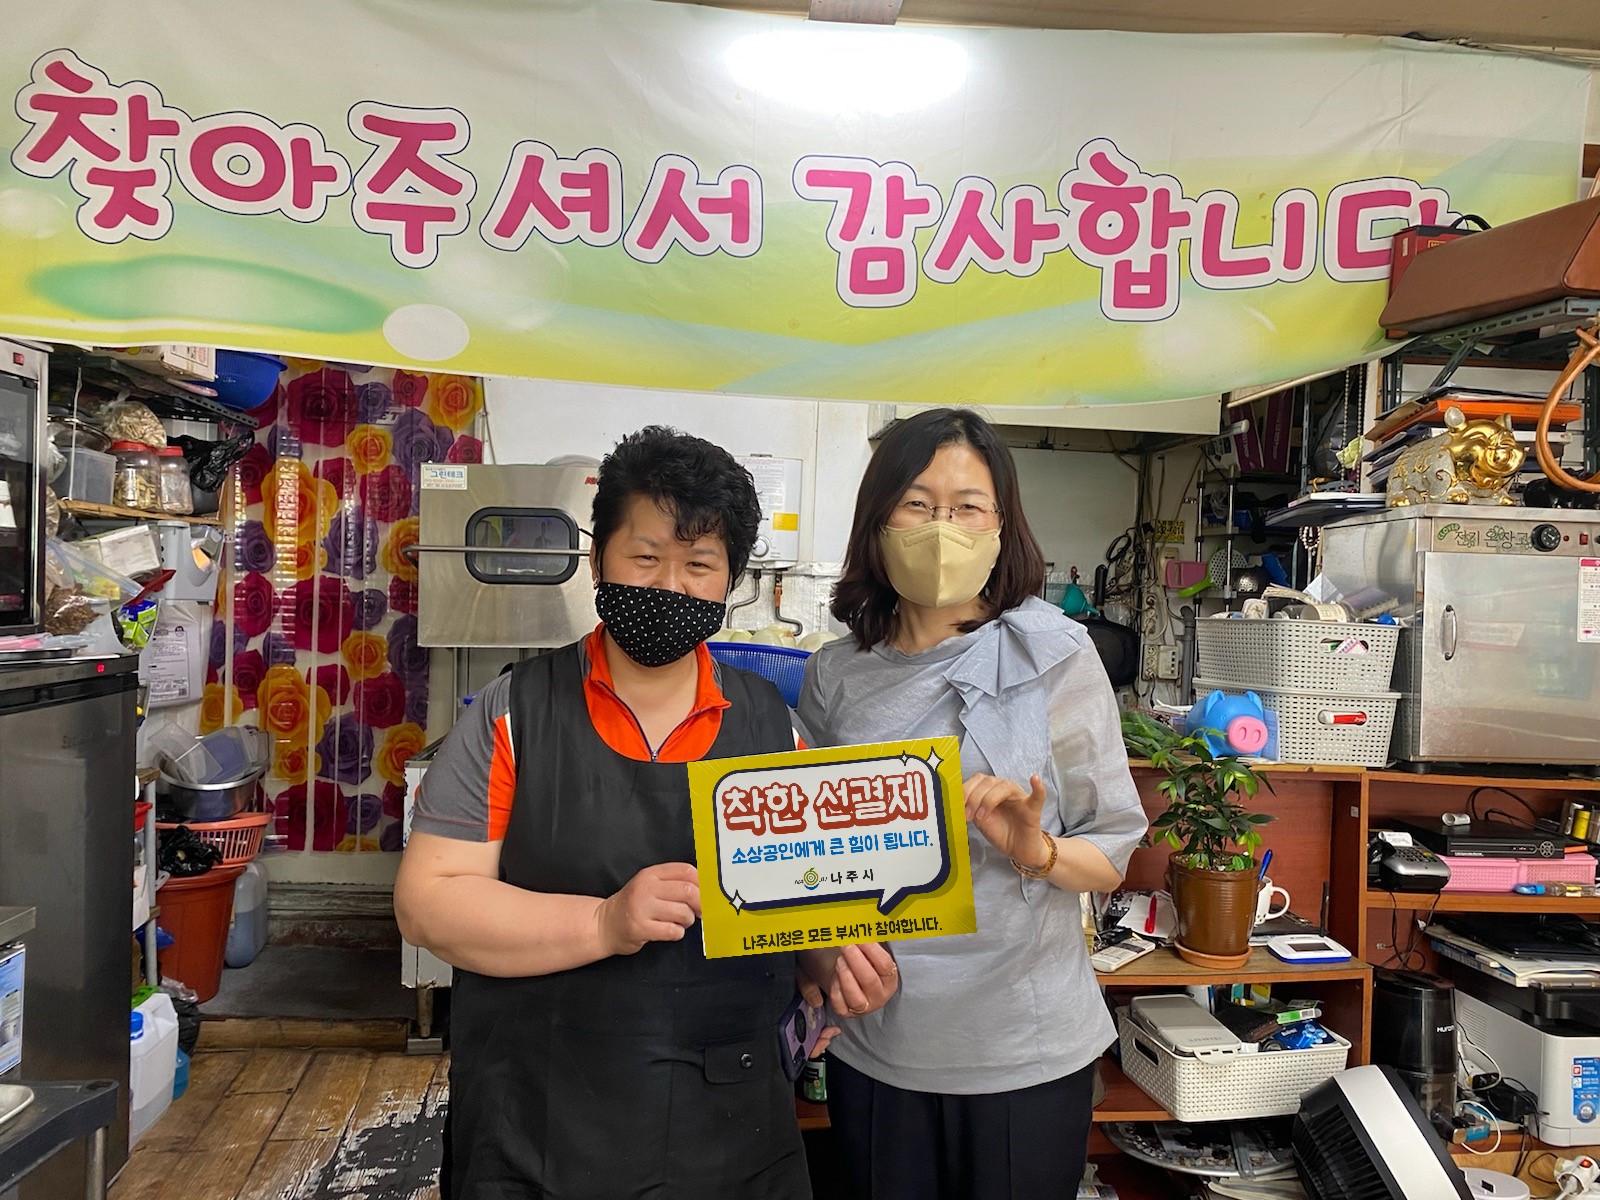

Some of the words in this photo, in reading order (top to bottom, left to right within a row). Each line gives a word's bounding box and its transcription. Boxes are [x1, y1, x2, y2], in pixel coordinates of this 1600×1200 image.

[26, 60, 750, 256] 찾아주셔서
[1454, 529, 1481, 548] 전기
[1483, 528, 1531, 550] 온장고
[722, 782, 809, 836] 착한
[813, 770, 929, 830] 선결제
[731, 840, 826, 865] 소상공인에게
[829, 837, 846, 856] 큰
[848, 834, 879, 854] 힘이
[883, 829, 935, 851] 됩니다.
[830, 868, 875, 885] 나주시
[743, 930, 805, 951] 나주시청은
[808, 926, 833, 943] 모든
[835, 922, 873, 940] 부서가
[875, 916, 943, 936] 참여합니다.
